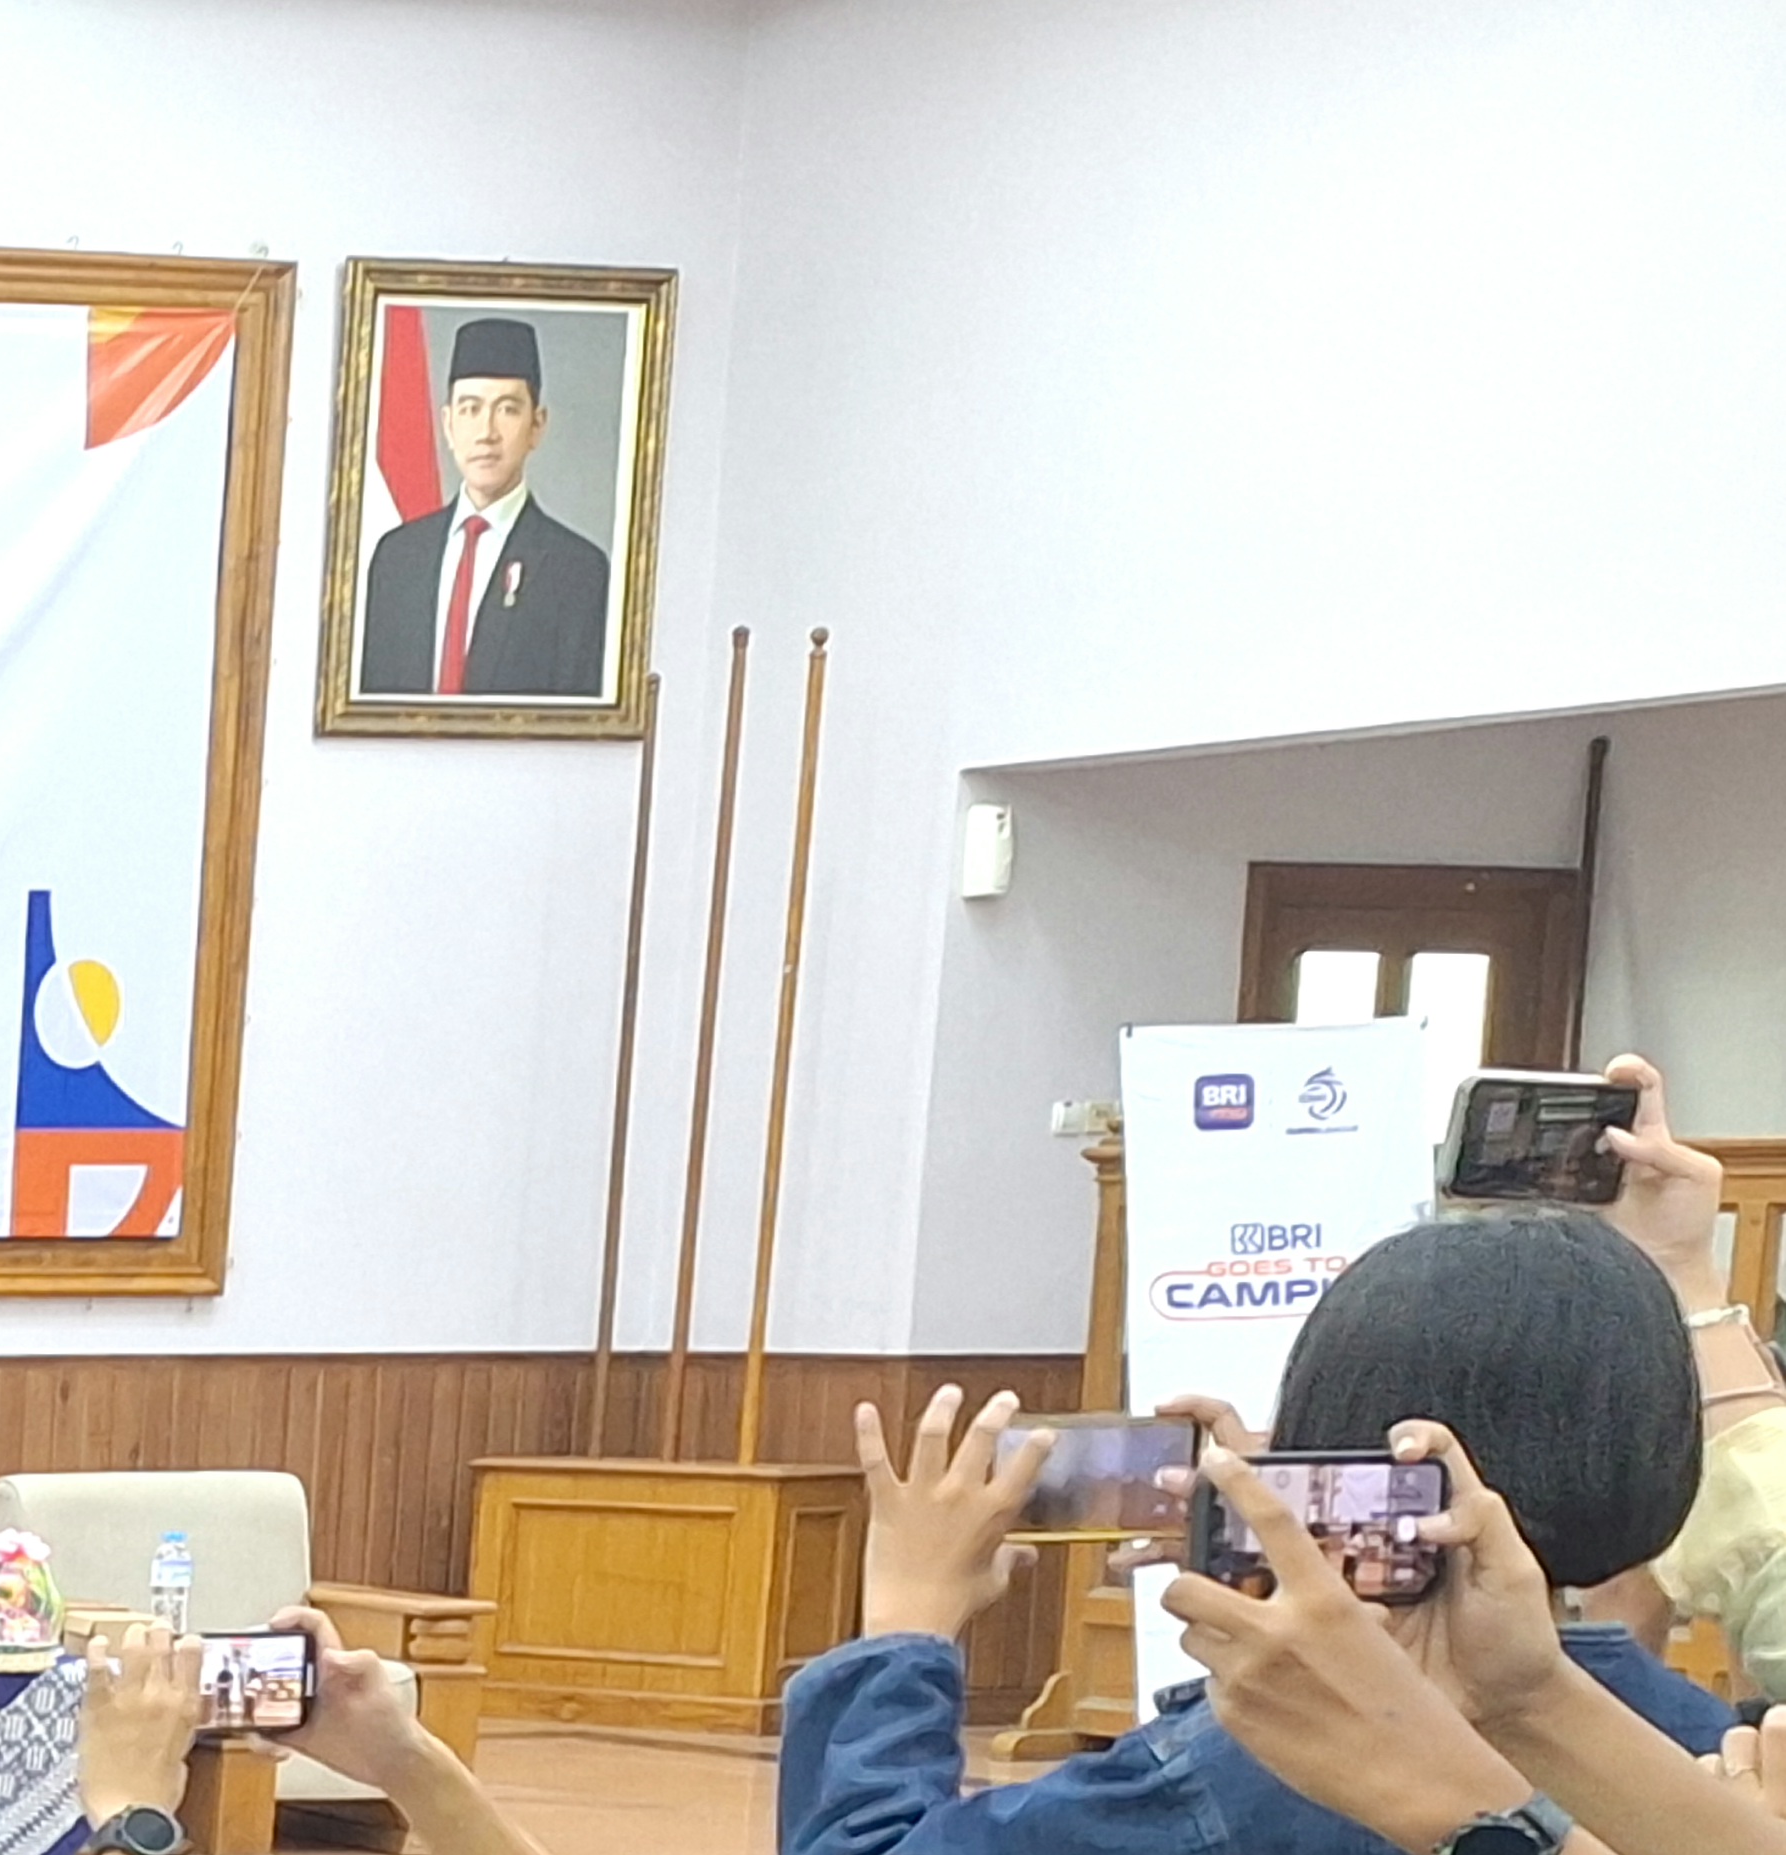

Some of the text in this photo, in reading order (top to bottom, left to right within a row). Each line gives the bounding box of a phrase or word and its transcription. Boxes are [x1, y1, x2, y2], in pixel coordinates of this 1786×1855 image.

[1201, 1083, 1248, 1107] BRI
[1267, 1222, 1323, 1251] BRI
[1206, 1255, 1348, 1278] GOES TO
[1165, 1276, 1333, 1310] CAMP
